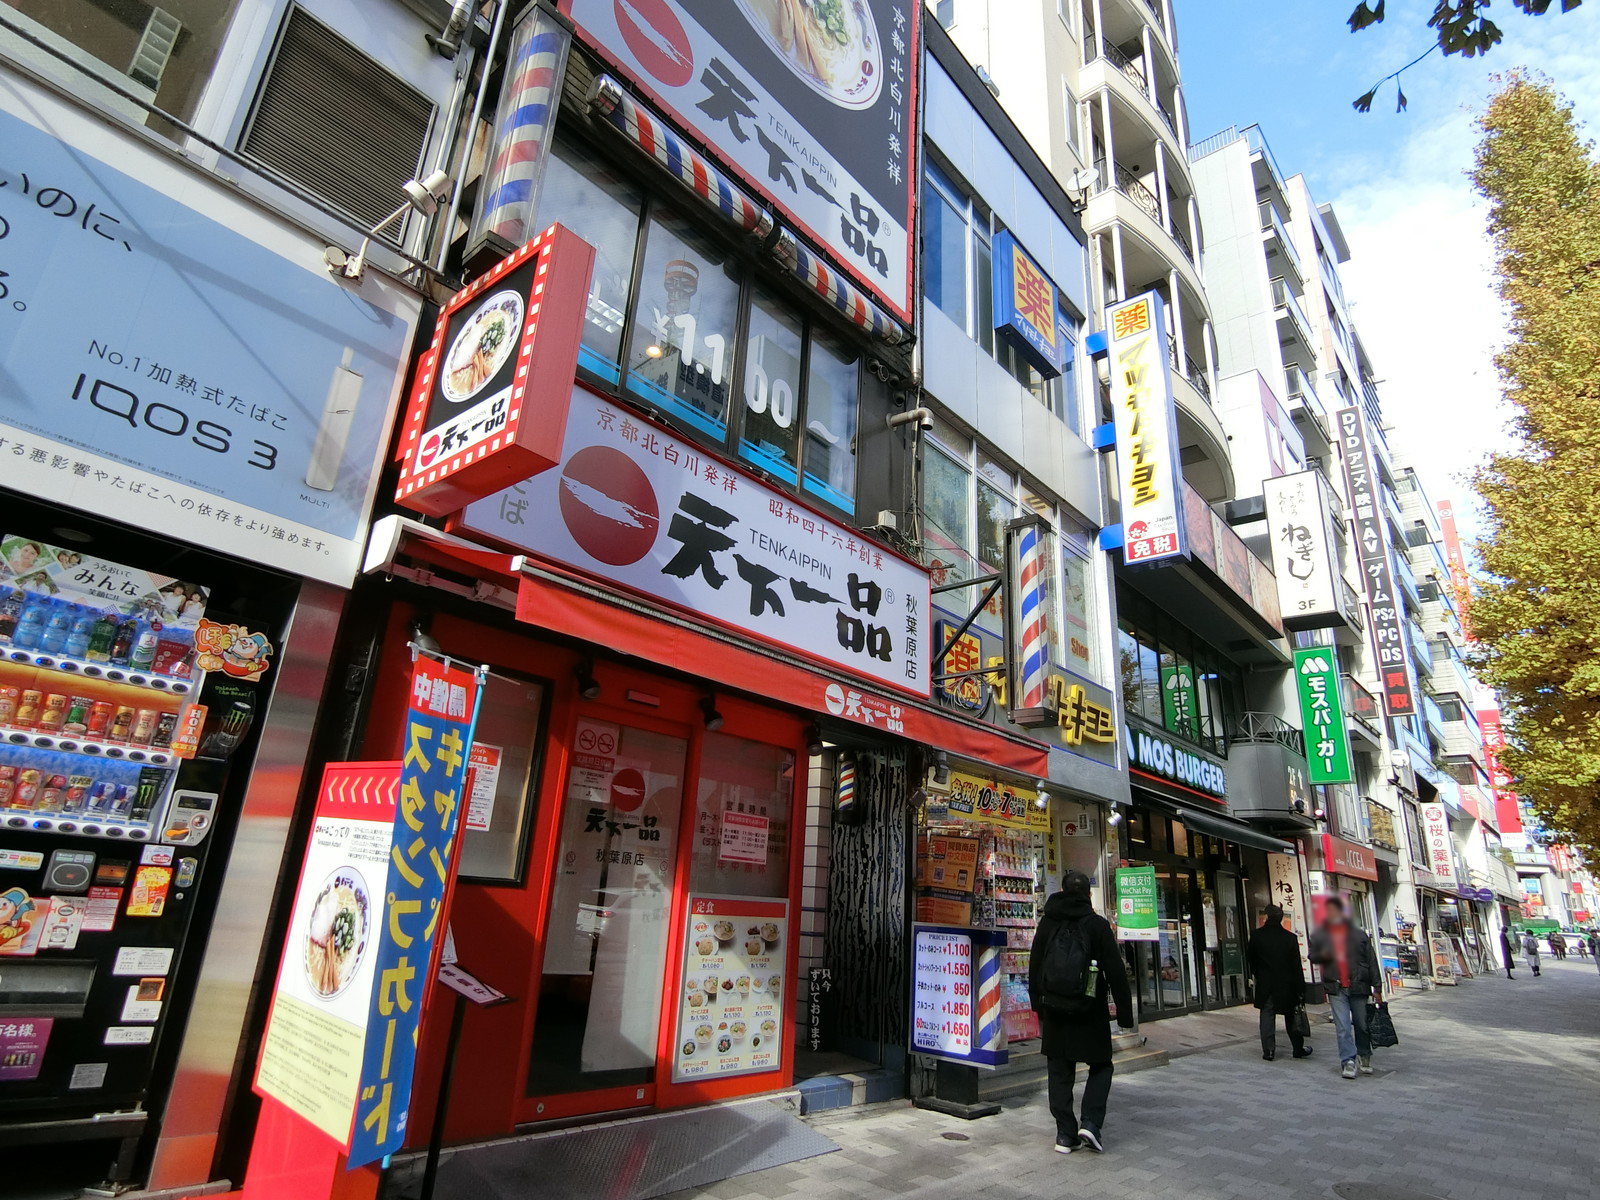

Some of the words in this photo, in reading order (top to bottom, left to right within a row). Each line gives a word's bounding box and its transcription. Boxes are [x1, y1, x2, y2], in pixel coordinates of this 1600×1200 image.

[886, 7, 907, 186] 京都北白川発祥
[695, 56, 889, 279] 天下一品
[767, 112, 838, 189] TENKAIPPIN
[1017, 254, 1054, 341] 薬
[1014, 311, 1057, 361] マツモトキヨシ
[1115, 301, 1149, 338] 薬
[88, 339, 141, 372] No.1
[147, 362, 288, 431] 加熱式たばこ
[71, 373, 232, 454] IQOS
[247, 439, 278, 470] 3
[439, 398, 506, 457] 天下一品
[1119, 338, 1160, 507] マツモトキヨシ
[1341, 411, 1361, 449] DVD
[597, 406, 739, 495] 京都北白川発祥
[299, 493, 331, 510] MULTI
[749, 527, 833, 581] TENKAIPPIN
[768, 497, 885, 572] 昭和四十六年創業
[1132, 534, 1173, 558] 免税
[1281, 522, 1316, 581] ねぎし
[73, 567, 140, 597] みんな
[661, 491, 892, 662] 天下一品
[1367, 562, 1390, 602] ゲーム
[1298, 599, 1316, 610] 3F
[1372, 606, 1396, 623] PS2
[903, 593, 919, 680] 秋葉原店
[1377, 627, 1399, 643] PC
[1381, 646, 1403, 663] DS
[845, 690, 904, 733] 天下一品
[1386, 673, 1410, 710] 買取
[187, 708, 203, 736] HOT
[1308, 676, 1336, 774] モスバーガー
[1138, 731, 1174, 776] MOS
[1174, 748, 1225, 796] BURGER
[584, 807, 661, 842] 天下一品
[726, 801, 767, 816] 営業時間
[596, 848, 645, 867] 秋葉原店
[1429, 824, 1451, 877] 桜の薬粧
[1120, 876, 1152, 887] 微信支付
[1120, 887, 1141, 895] WeChat
[695, 900, 715, 914] 定食
[821, 967, 832, 993] 只今
[810, 968, 821, 1052] すいております
[917, 1000, 935, 1011] フルコース
[917, 1037, 936, 1047] HIRO
